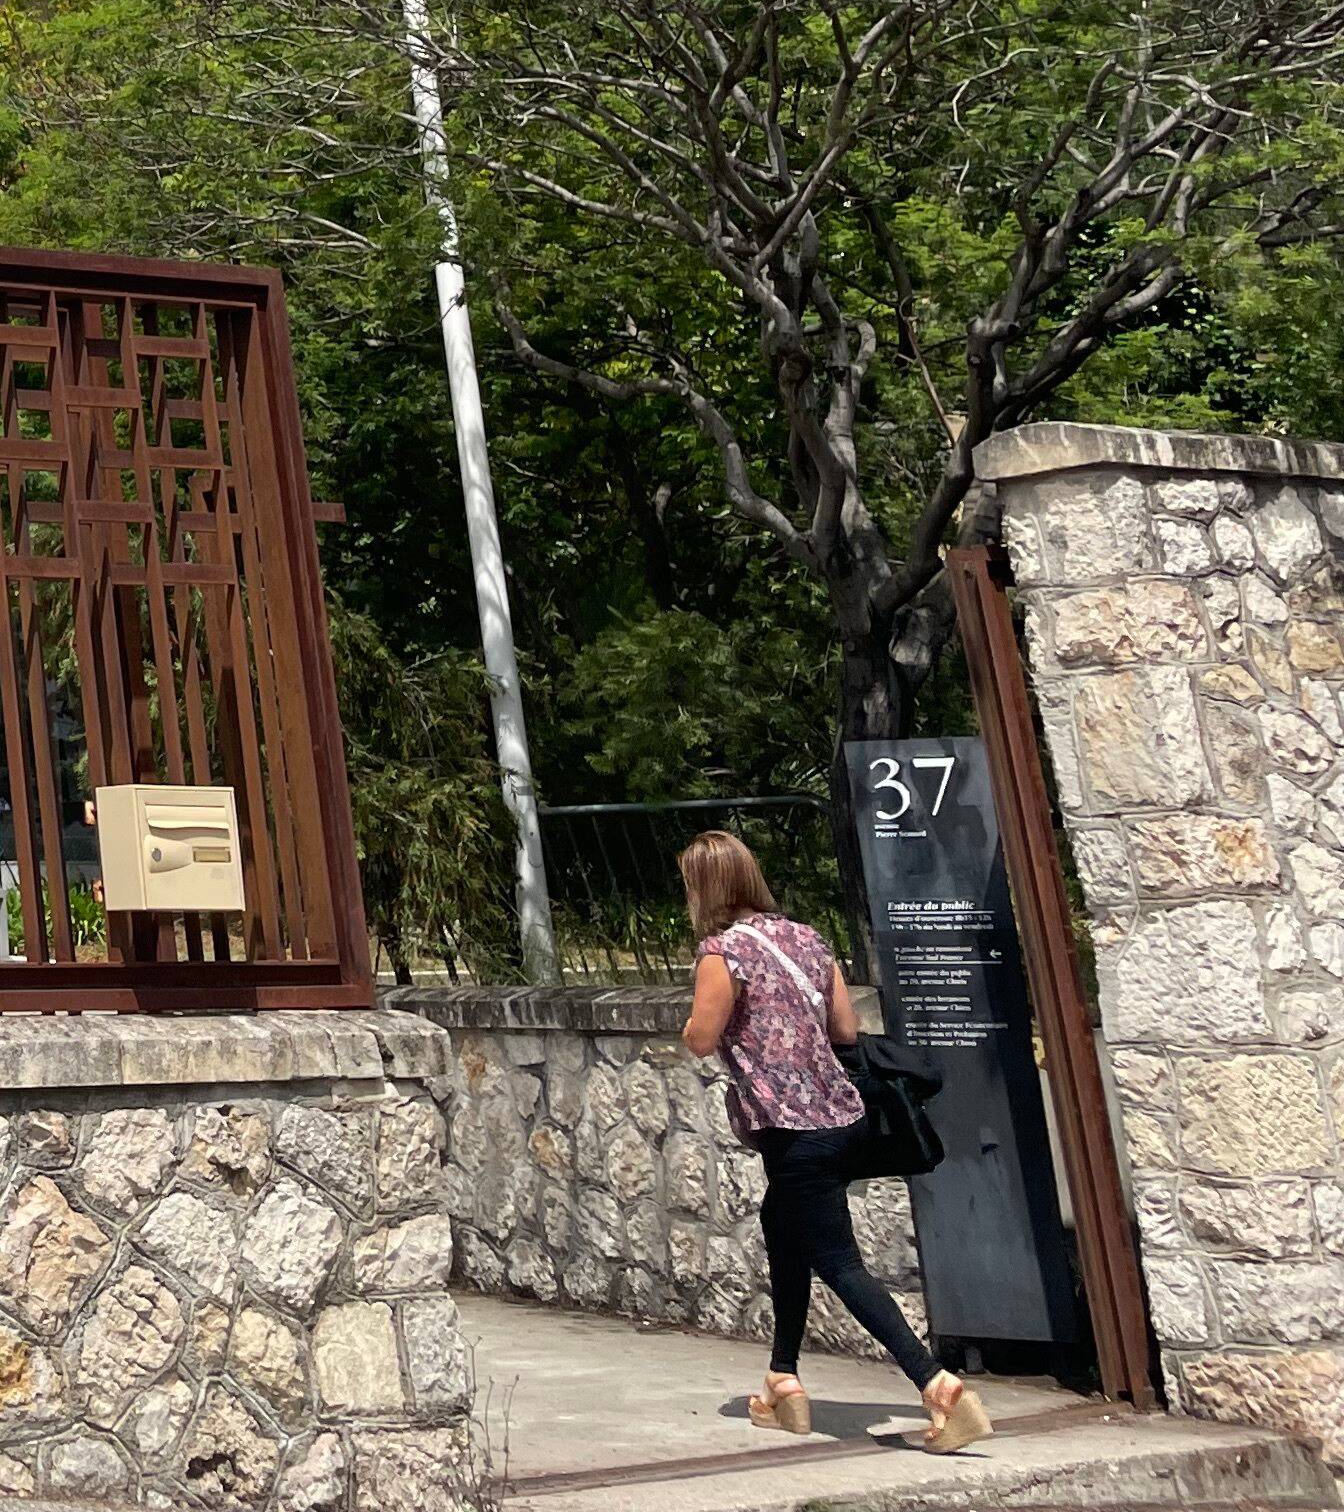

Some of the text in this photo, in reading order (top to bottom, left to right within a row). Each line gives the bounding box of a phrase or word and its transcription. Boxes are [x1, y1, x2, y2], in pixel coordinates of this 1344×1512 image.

[869, 757, 955, 820] 37
[887, 900, 976, 910] Entrée du public
